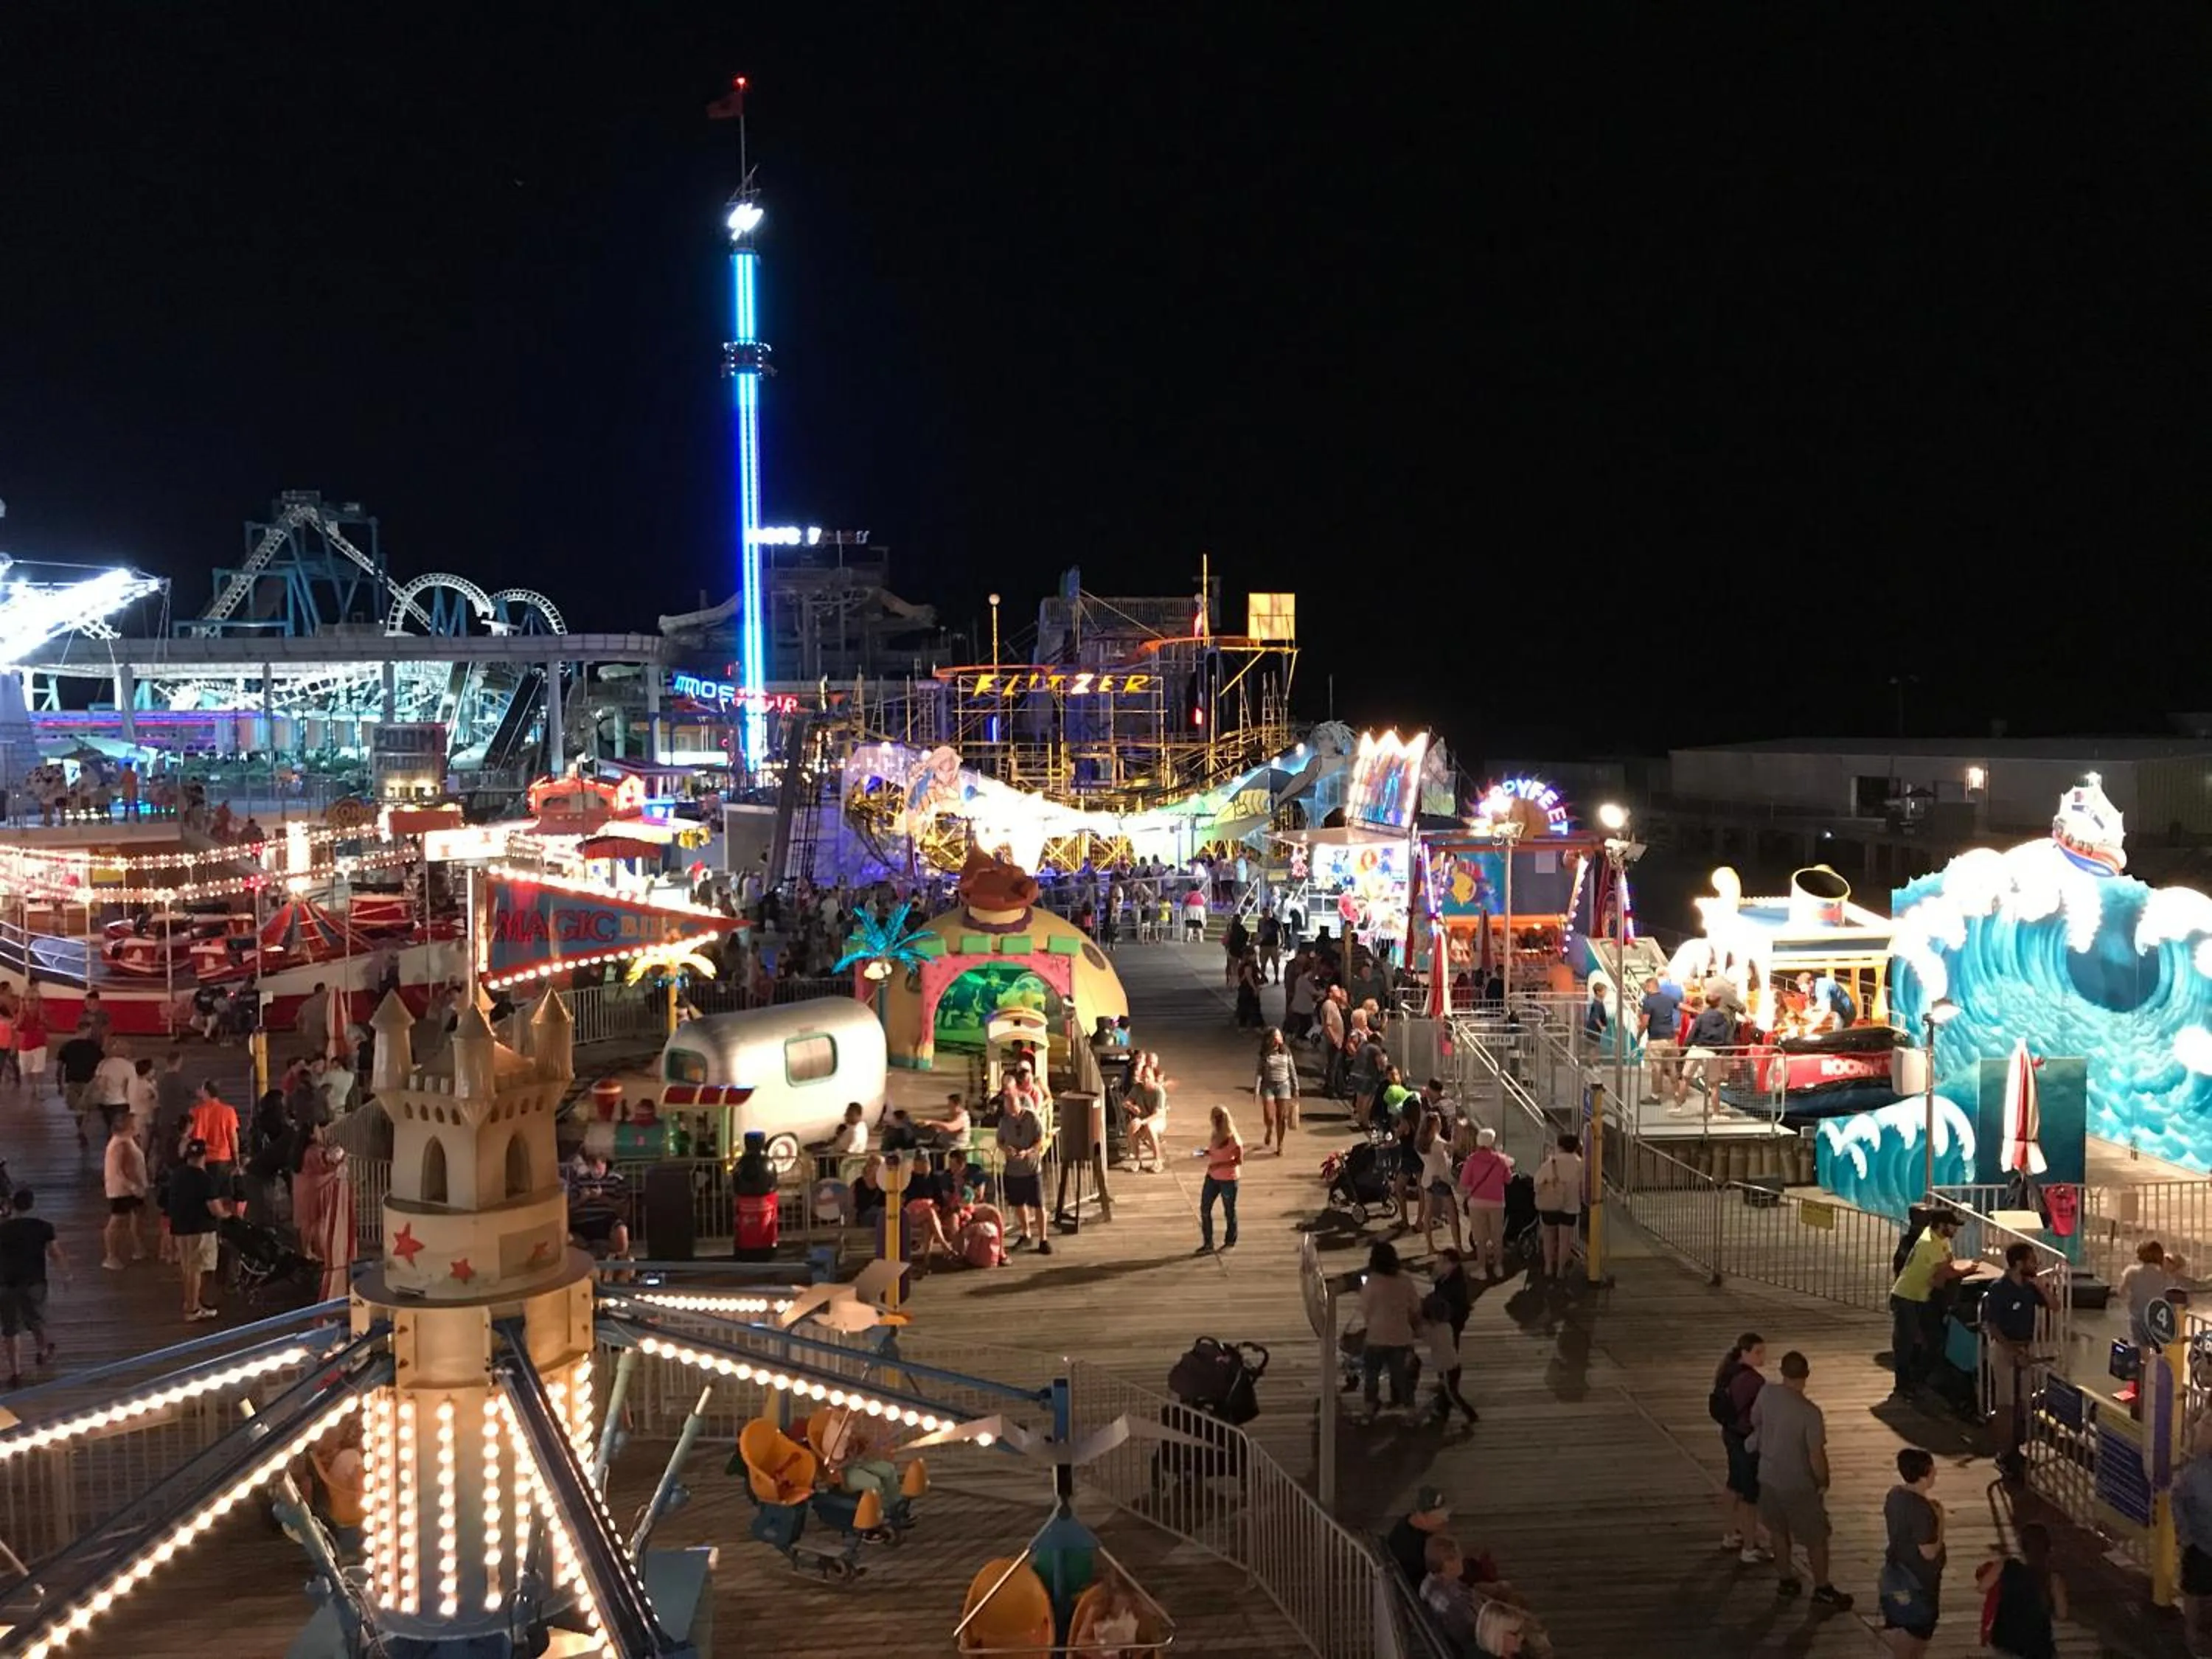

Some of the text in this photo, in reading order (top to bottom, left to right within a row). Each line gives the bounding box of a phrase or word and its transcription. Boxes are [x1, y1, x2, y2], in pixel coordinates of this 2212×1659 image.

[973, 672, 1150, 697] FLITZER
[493, 909, 616, 943] MAGIC
[2156, 1307, 2168, 1328] 4
